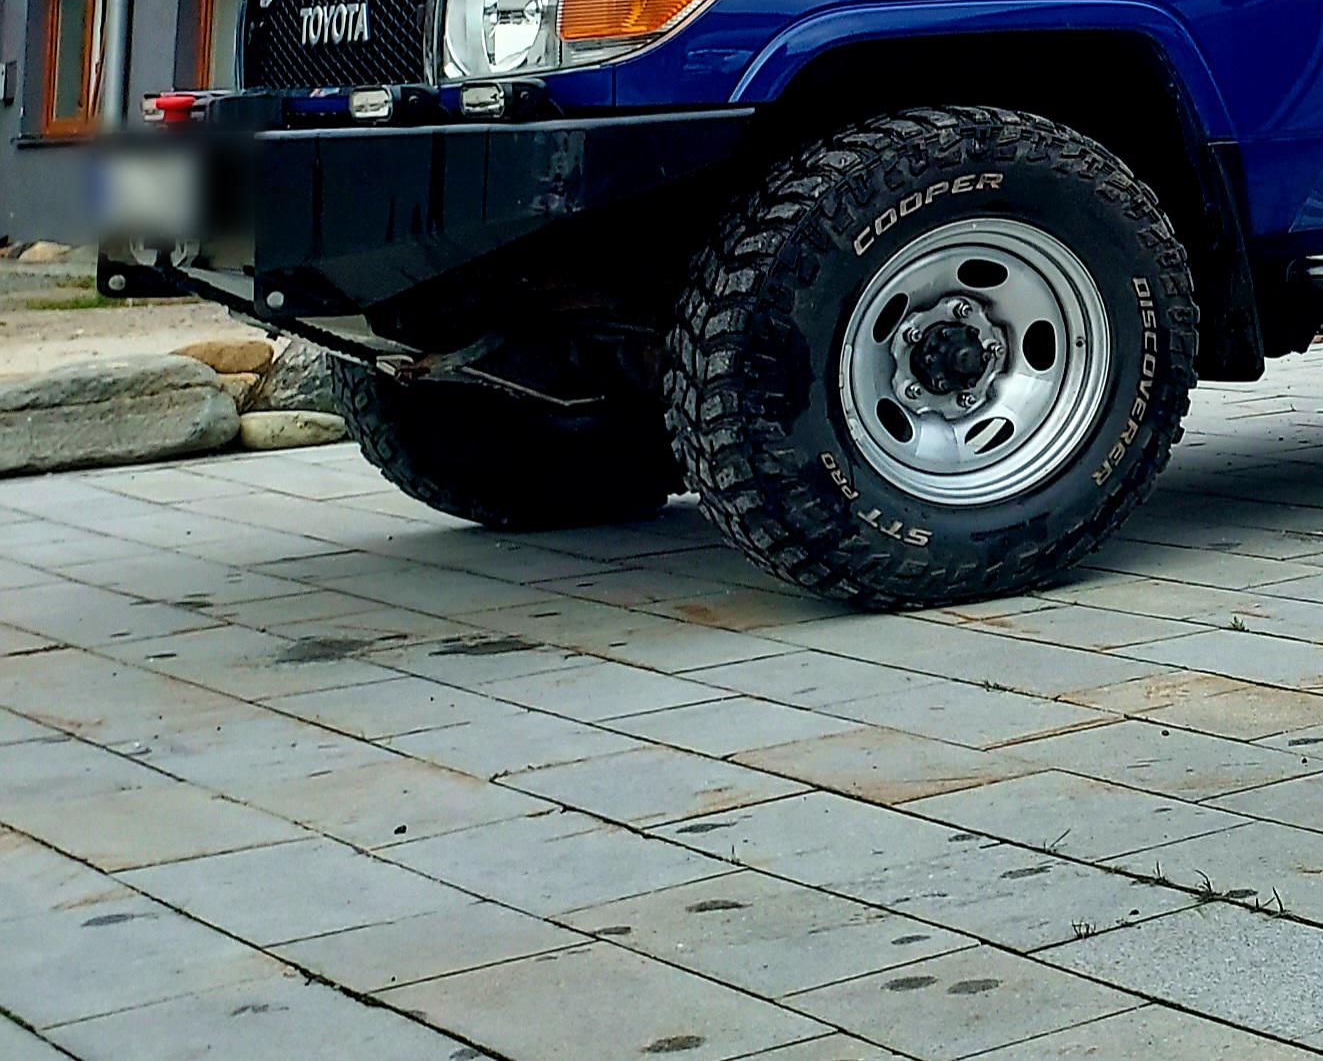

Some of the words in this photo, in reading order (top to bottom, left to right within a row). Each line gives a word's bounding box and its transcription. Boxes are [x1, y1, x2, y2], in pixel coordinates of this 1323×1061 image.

[300, 2, 370, 46] TOYOTA
[853, 172, 1004, 256] COOPER
[1091, 276, 1158, 487] DISCOVERER
[821, 452, 859, 499] PRO
[857, 508, 933, 546] STT
